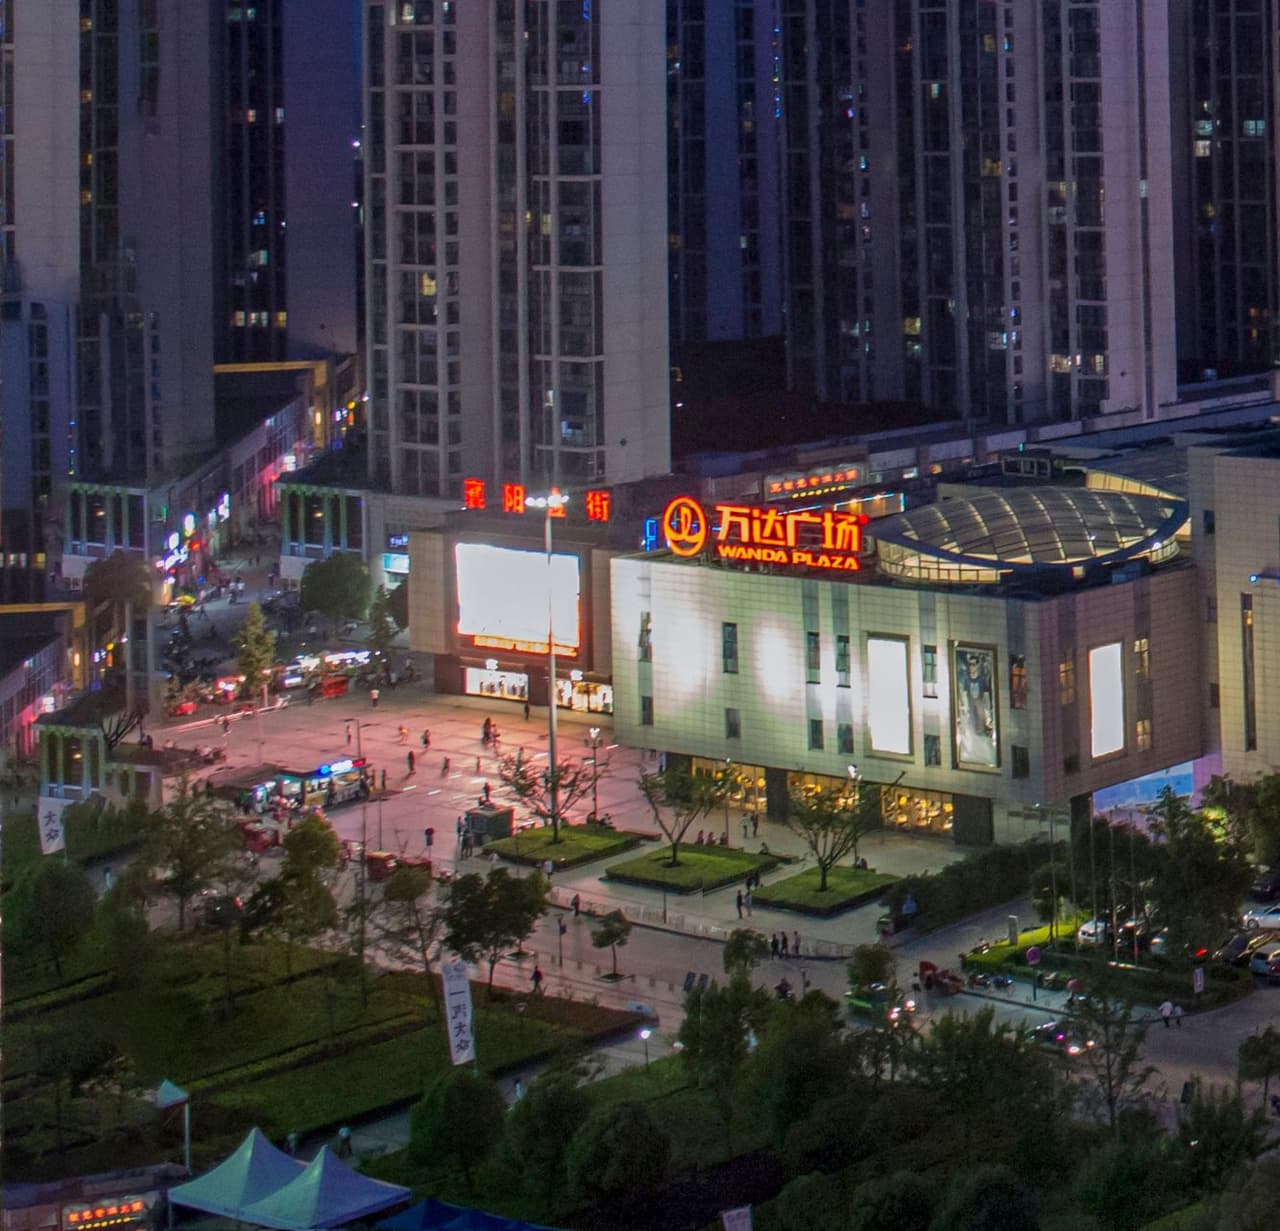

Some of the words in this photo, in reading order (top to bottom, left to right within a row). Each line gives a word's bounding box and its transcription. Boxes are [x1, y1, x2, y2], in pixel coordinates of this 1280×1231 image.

[715, 505, 861, 552] 万达广场
[717, 544, 788, 563] WANDA
[792, 550, 860, 571] PLAZA
